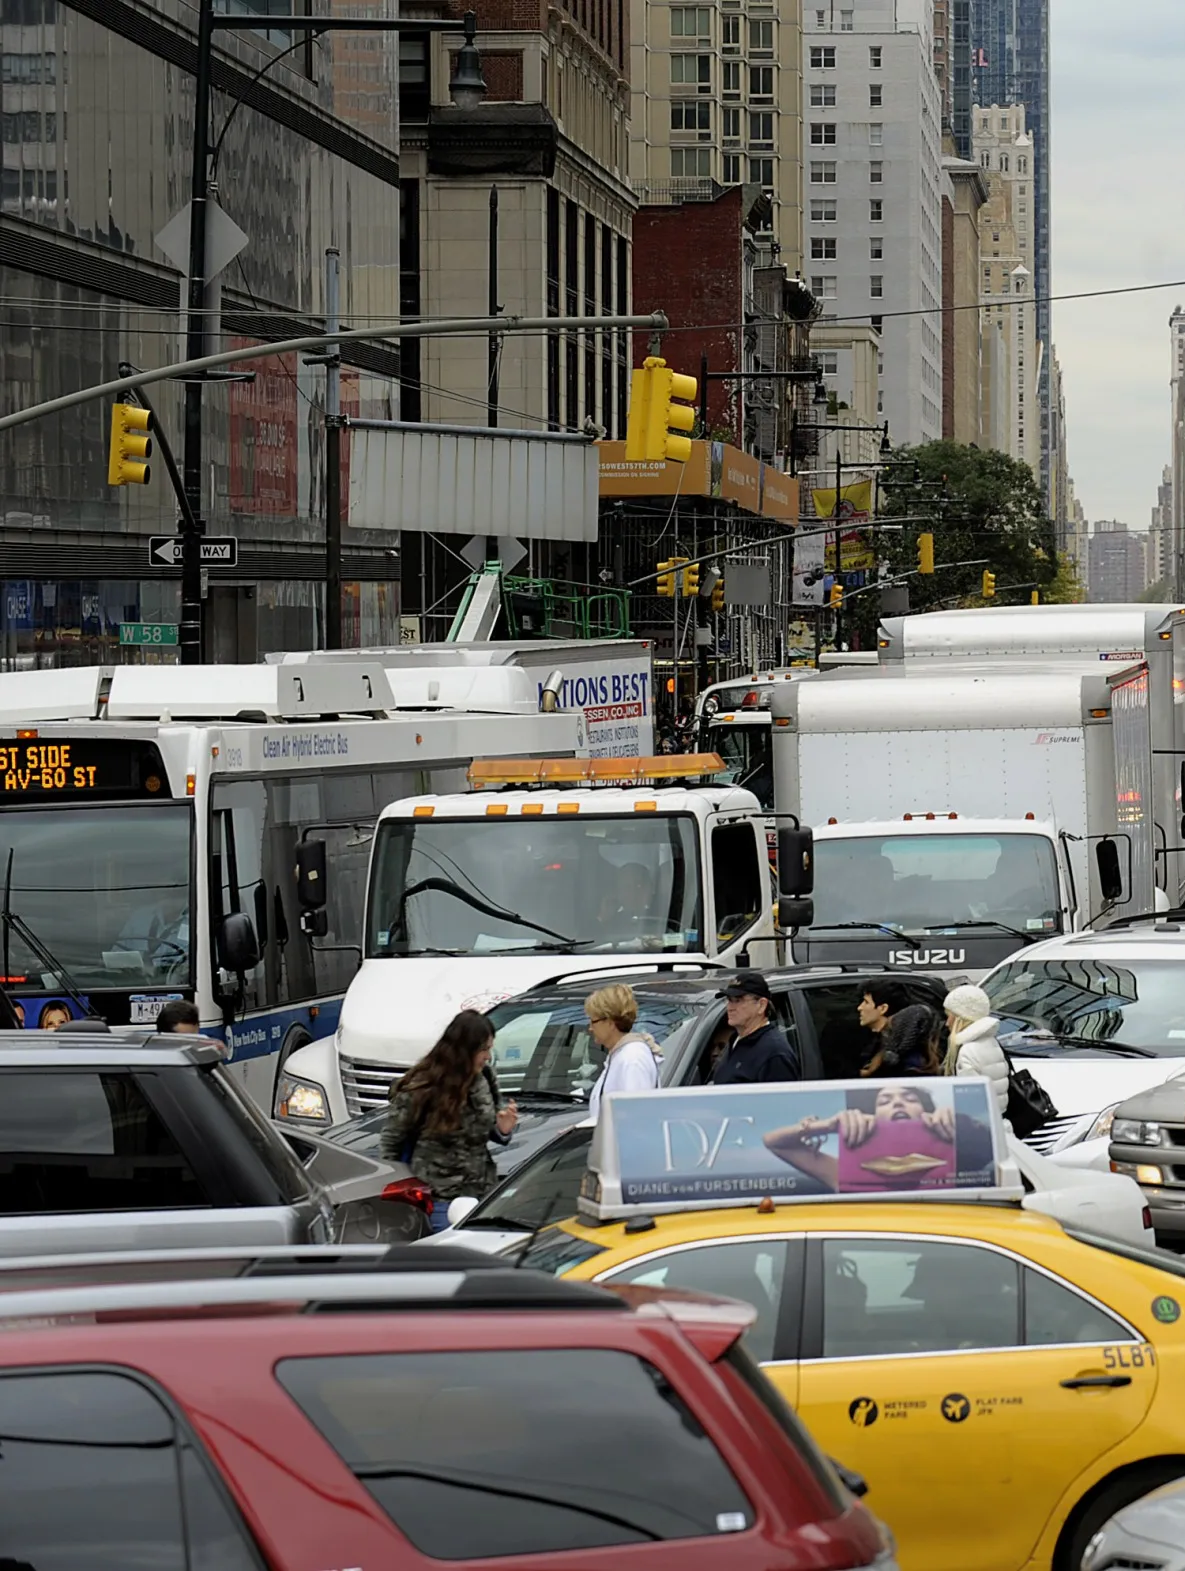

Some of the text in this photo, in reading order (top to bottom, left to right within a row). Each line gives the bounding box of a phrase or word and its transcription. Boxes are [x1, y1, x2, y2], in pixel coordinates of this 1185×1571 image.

[203, 545, 228, 557] WAY
[7, 596, 27, 619] CHASE
[82, 596, 99, 618] CHASE
[123, 628, 135, 642] W
[142, 627, 162, 643] 58
[538, 672, 648, 716] TIONS BEST
[262, 733, 348, 762] Clean Air Hybrid Electric Bus
[1049, 736, 1081, 744] SUPREME
[26, 745, 71, 769] SIDE
[5, 766, 96, 790] AV-60 ST
[888, 948, 966, 965] ISUZU
[627, 1176, 797, 1196] DIANE von FURSTENBERG
[883, 1400, 928, 1410] METERED
[975, 1397, 1023, 1406] FLAT FARE
[884, 1410, 908, 1419] FARE
